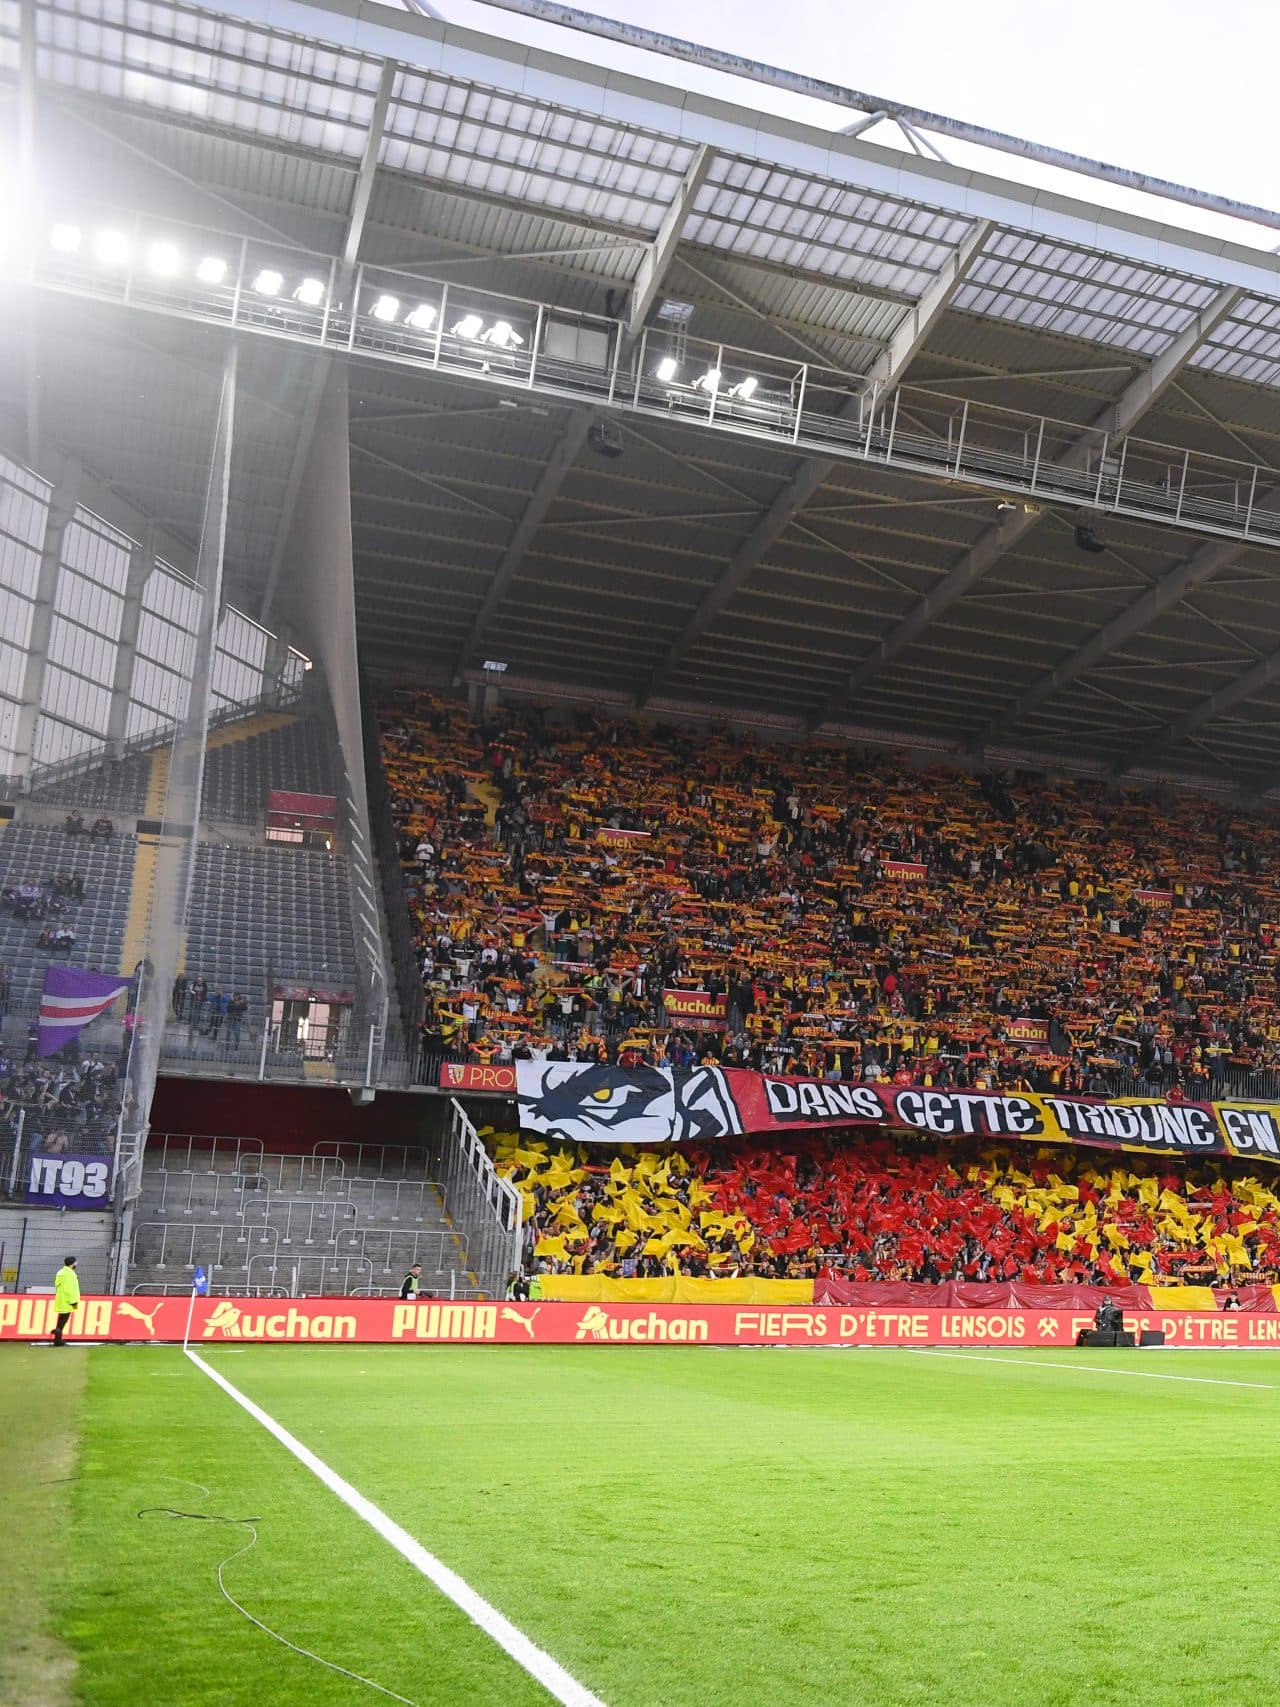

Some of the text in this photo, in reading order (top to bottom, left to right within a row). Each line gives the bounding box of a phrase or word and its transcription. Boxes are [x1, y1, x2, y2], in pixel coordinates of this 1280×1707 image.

[664, 994, 726, 1015] Auchan
[1006, 1024, 1047, 1040] uchan
[470, 1067, 516, 1088] PRO
[765, 1078, 883, 1119] DANS
[896, 1090, 1035, 1133] CETTE
[1044, 1097, 1216, 1146] TRIBUNE
[28, 1157, 109, 1198] IT93
[201, 1301, 357, 1339] Auchan
[391, 1305, 497, 1339] PUMA
[575, 1305, 708, 1341] Auchan
[735, 1311, 1025, 1339] FIERS D'ÊTRE LENSOIS
[1161, 1315, 1238, 1341] D'ÊTRE
